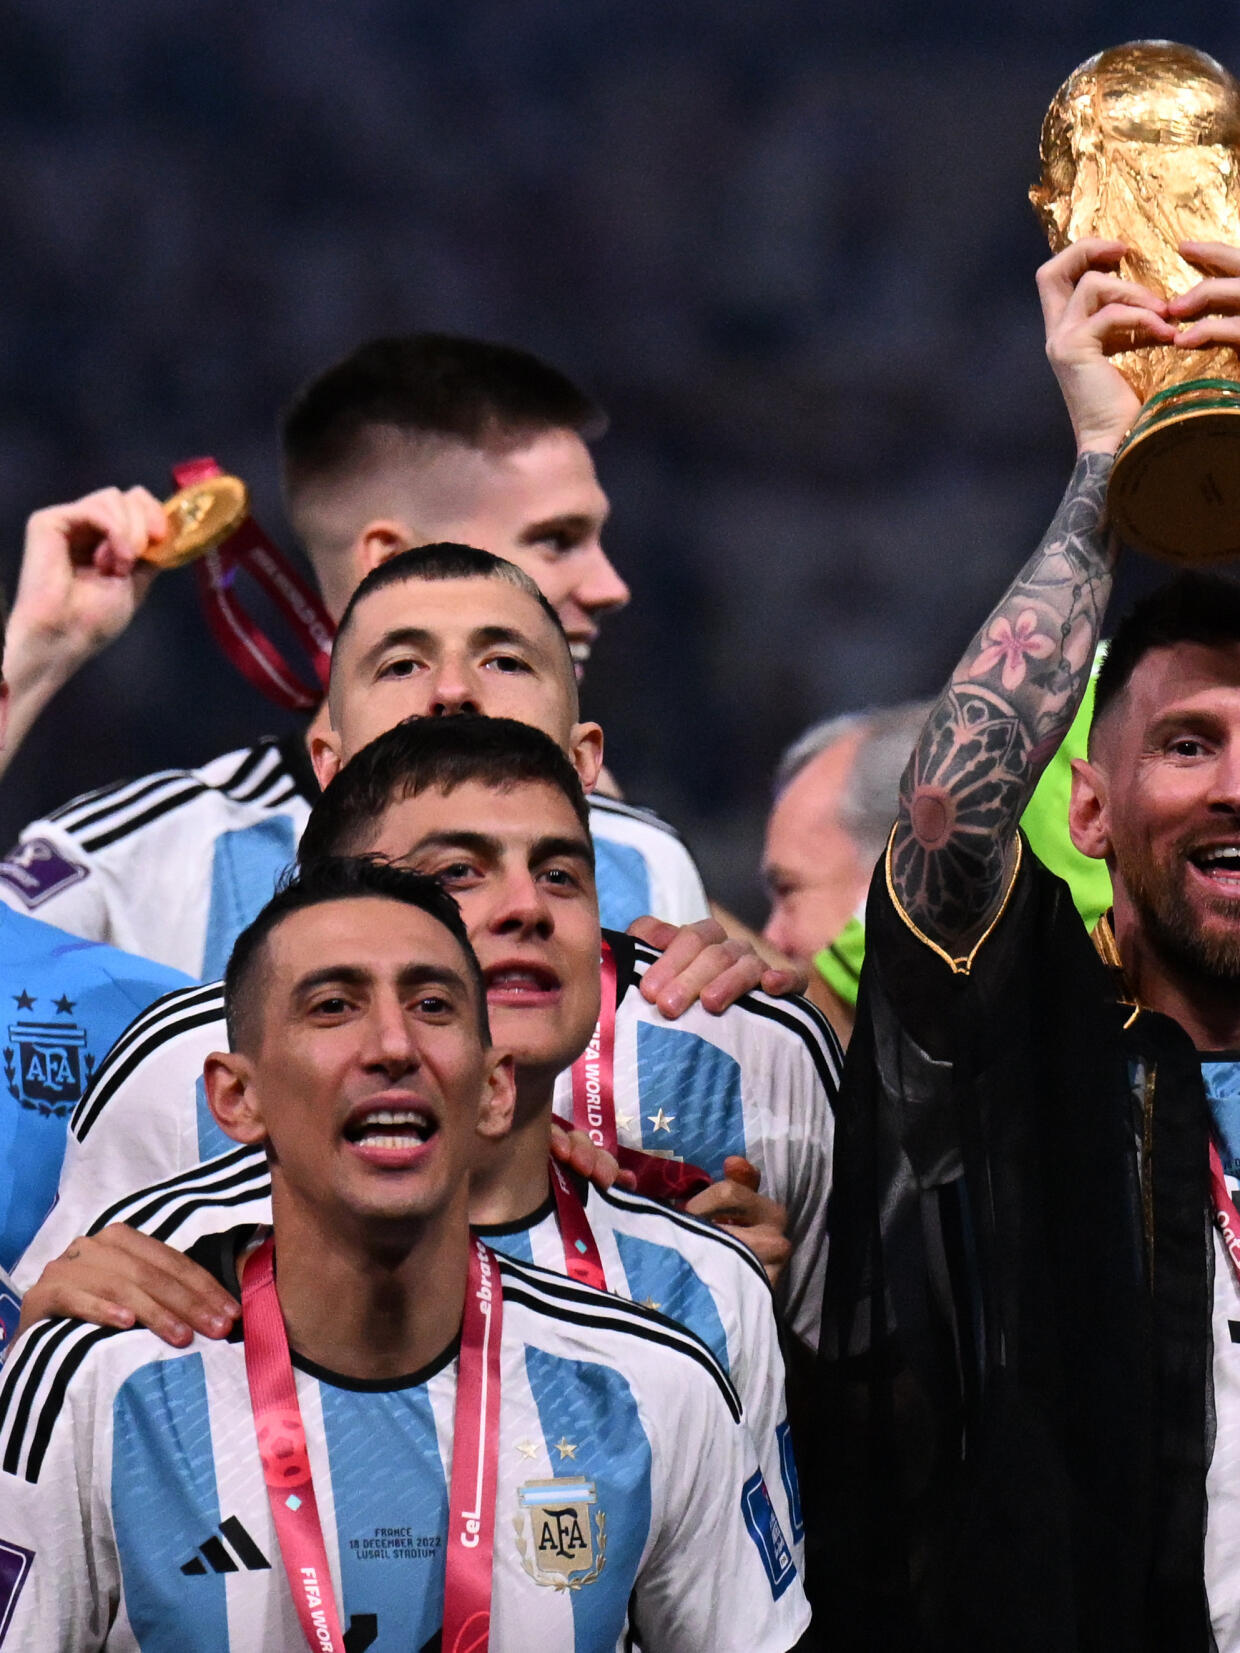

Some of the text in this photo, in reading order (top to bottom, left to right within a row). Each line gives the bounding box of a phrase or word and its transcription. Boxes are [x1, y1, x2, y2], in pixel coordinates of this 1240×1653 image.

[26, 1042, 77, 1092] AFA
[586, 1063, 603, 1126] WORLD
[349, 1537, 441, 1550] 18 DECEMBER 2022
[374, 1527, 413, 1538] FRANCE
[538, 1507, 588, 1559] AFA
[356, 1549, 436, 1560] LUSAIL STADIUM
[301, 1566, 322, 1609] FIFA
